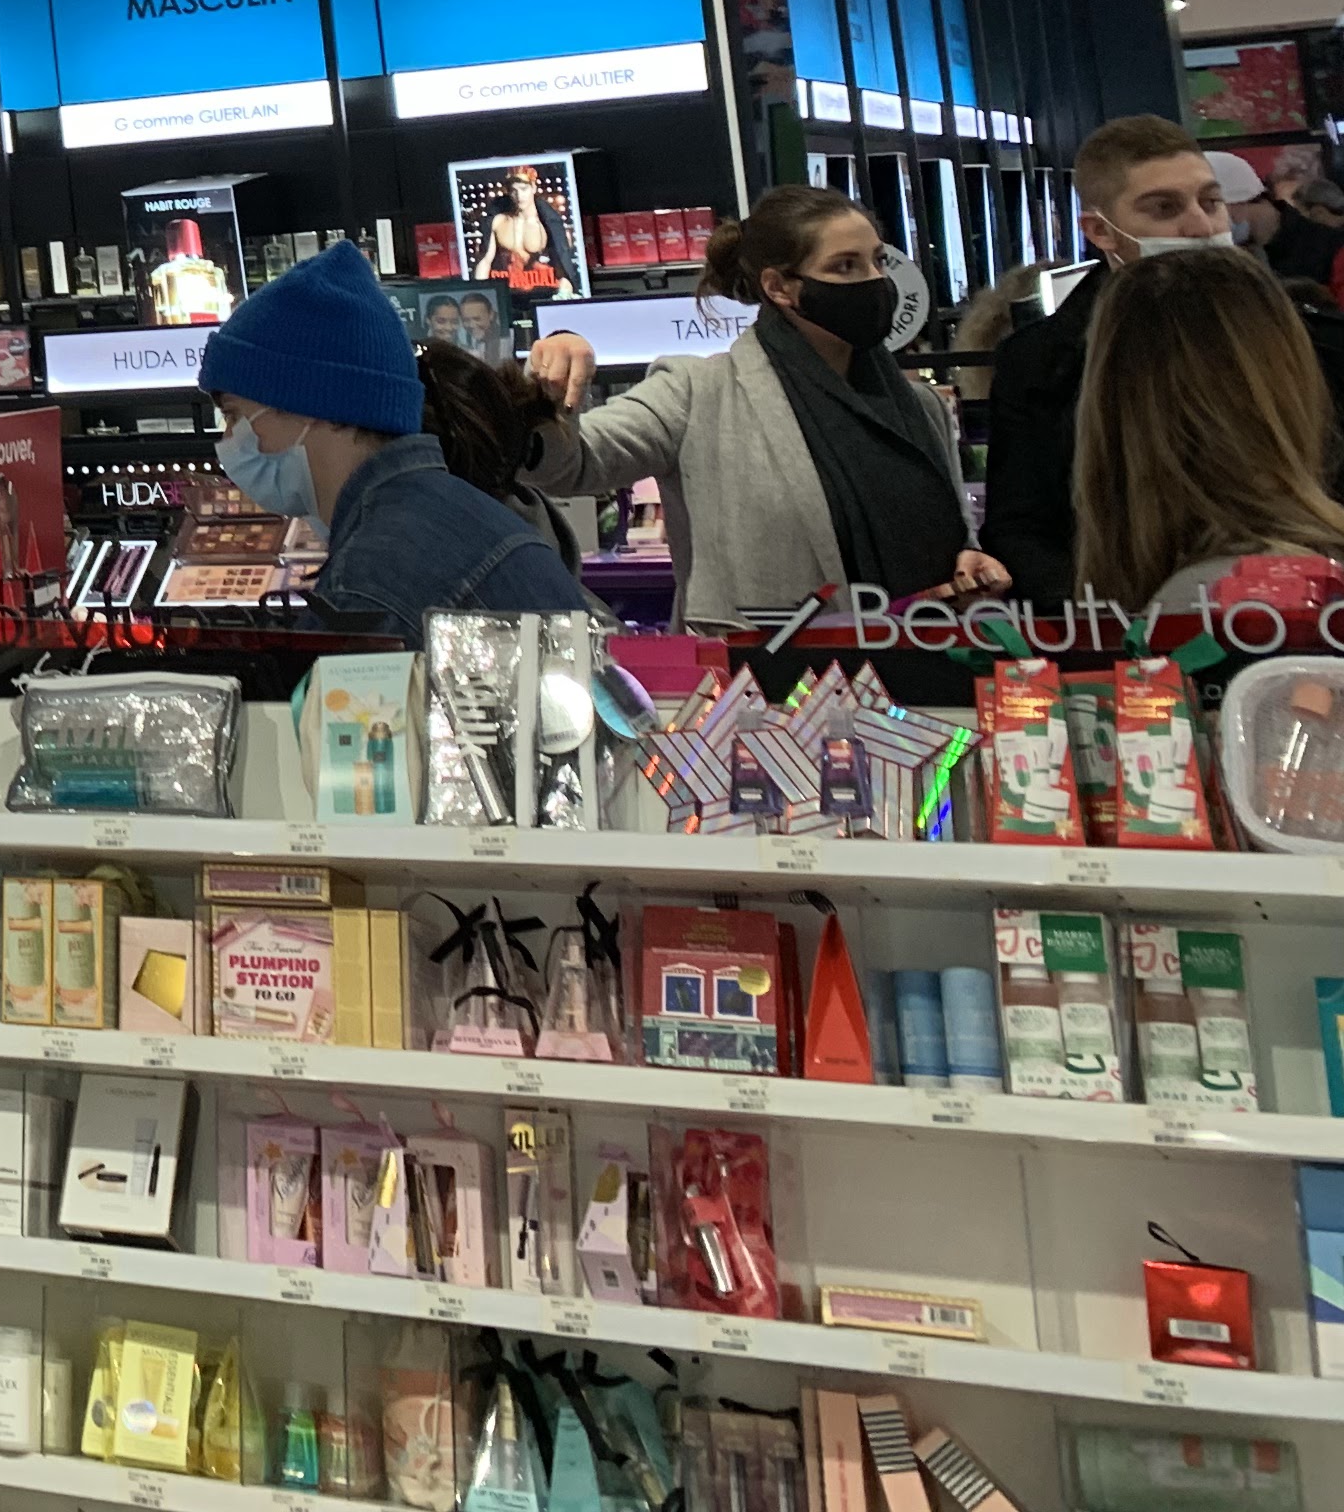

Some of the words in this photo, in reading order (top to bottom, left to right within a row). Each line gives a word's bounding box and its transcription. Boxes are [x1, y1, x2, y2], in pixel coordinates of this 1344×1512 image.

[458, 85, 474, 100] G
[480, 78, 548, 98] comme
[554, 68, 635, 91] GAULTIER
[114, 116, 128, 131] G
[133, 110, 194, 130] comme
[198, 103, 279, 123] GUERLAIN
[145, 199, 173, 213] HABIT
[174, 196, 212, 210] ROUGE
[670, 316, 749, 341] TARTE
[113, 350, 178, 371] HUDA
[102, 482, 169, 506] HUDA
[850, 582, 1162, 653] Beauty
[1191, 583, 1287, 654] to
[236, 972, 314, 989] STATION
[254, 989, 272, 1001] TO
[275, 990, 296, 1002] GO
[1017, 1074, 1053, 1086] GRAB
[1058, 1076, 1086, 1087] AND
[1195, 1092, 1224, 1103] AND
